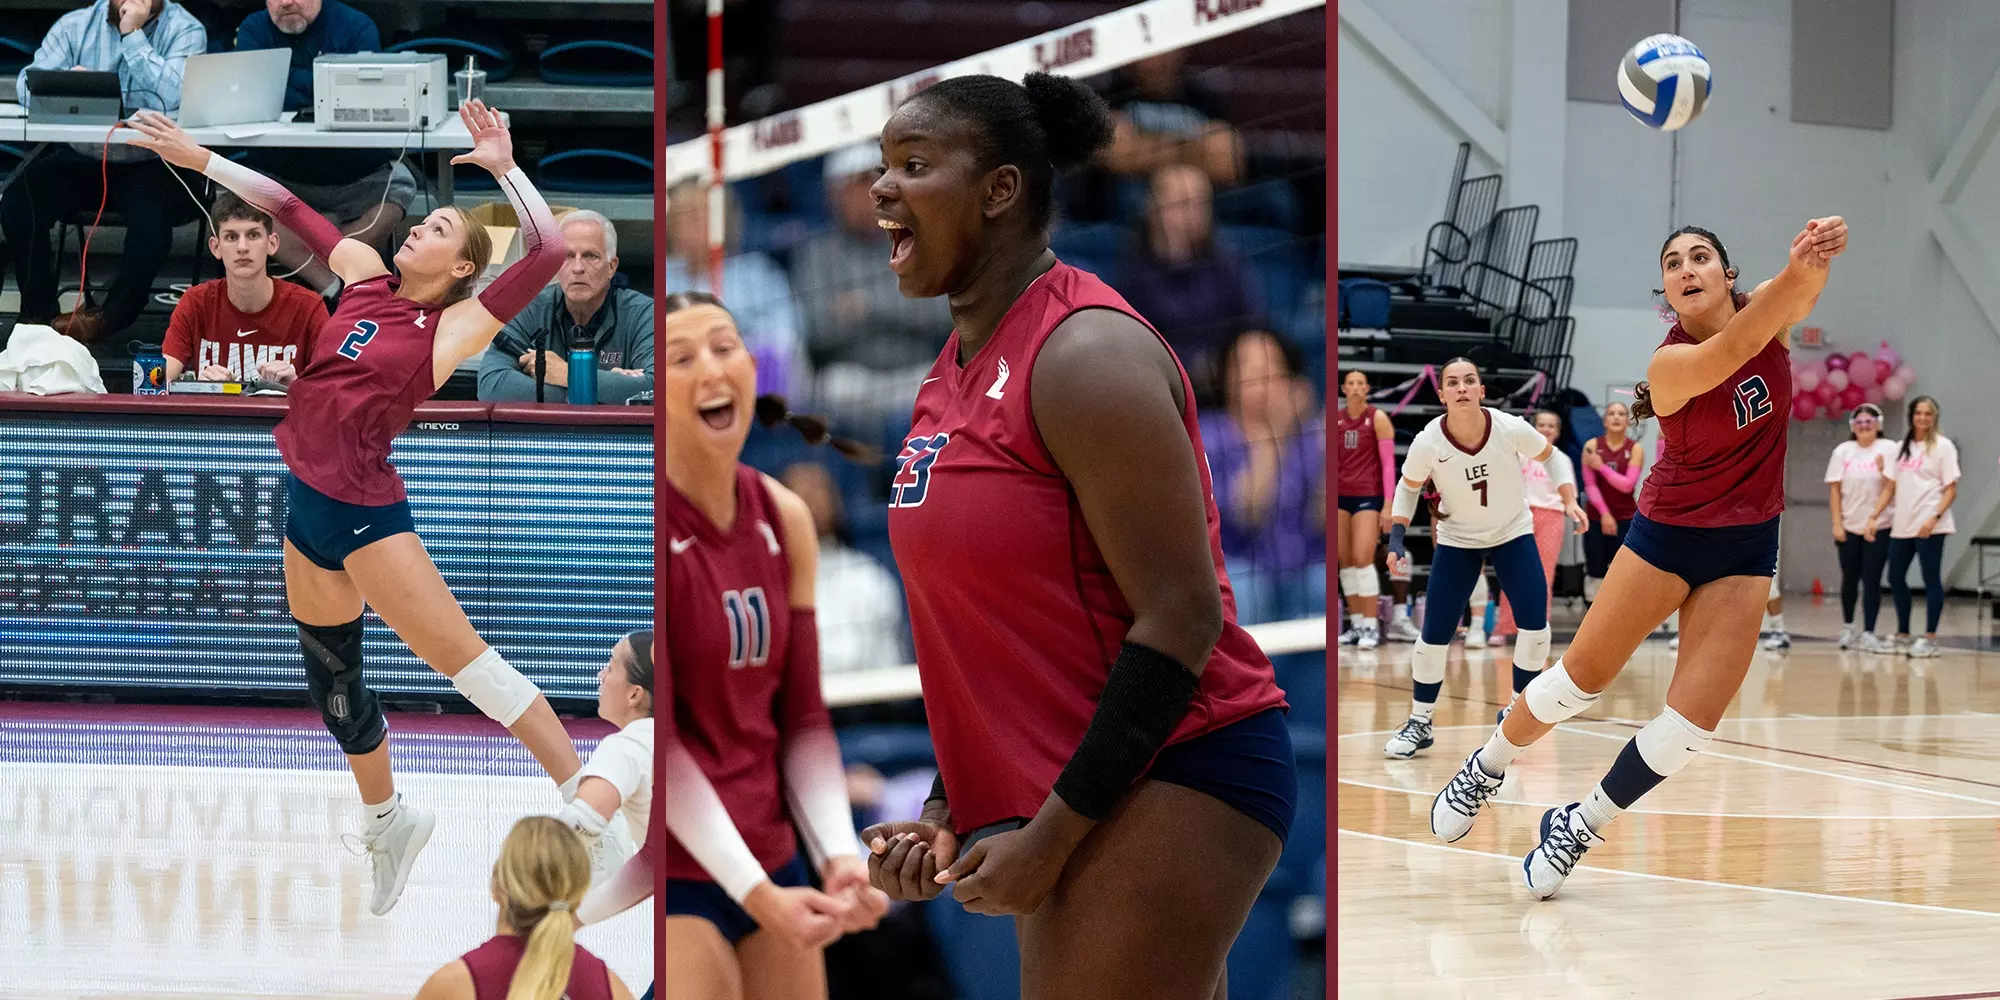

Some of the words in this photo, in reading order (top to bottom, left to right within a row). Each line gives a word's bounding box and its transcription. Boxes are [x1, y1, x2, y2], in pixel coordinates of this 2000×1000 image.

[336, 319, 380, 361] 2
[600, 350, 624, 363] LEE
[1733, 375, 1773, 430] 12
[424, 422, 460, 430] NEVCO
[1465, 464, 1489, 481] LEE
[1471, 480, 1488, 507] 7
[722, 586, 771, 669] 11
